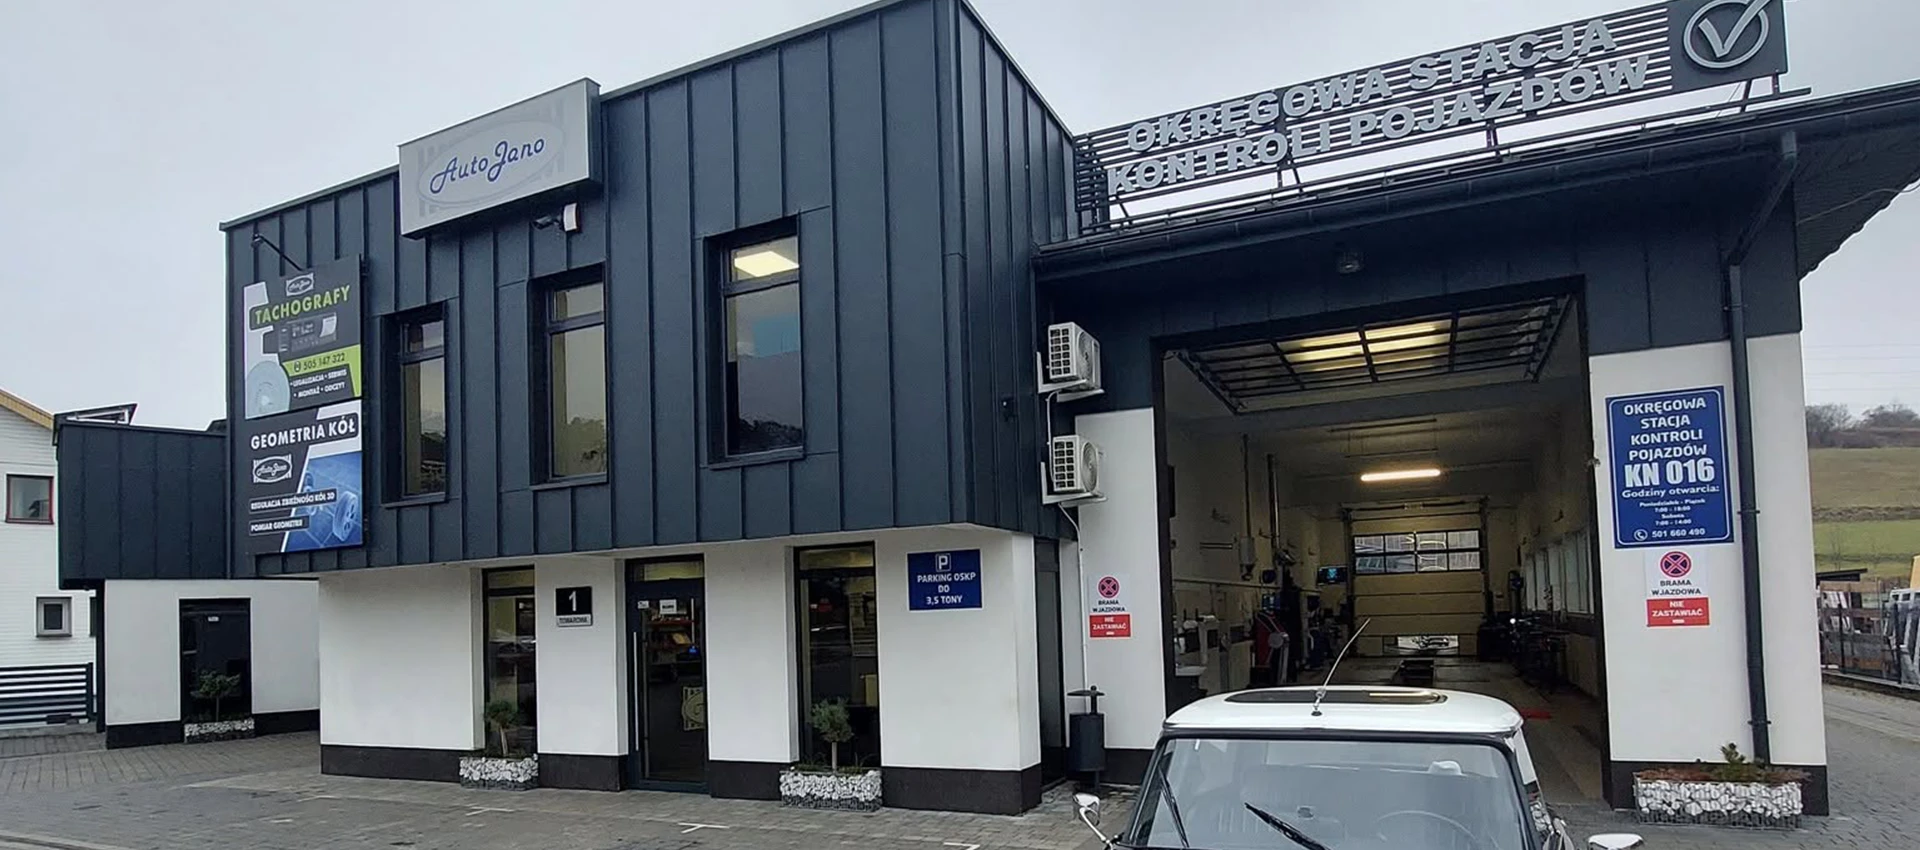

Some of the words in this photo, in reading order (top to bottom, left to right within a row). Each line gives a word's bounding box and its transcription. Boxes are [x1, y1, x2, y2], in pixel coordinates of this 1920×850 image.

[1127, 68, 1393, 152] OKRĘGOWA
[1409, 20, 1617, 90] STACJA
[1107, 121, 1331, 195] KONTROLI
[1350, 55, 1649, 147] POJAZDÓW
[255, 285, 350, 324] TACHOGRAFY
[303, 359, 317, 371] 505
[331, 352, 345, 364] 322
[324, 381, 345, 392] ODCZYT
[1623, 397, 1707, 416] OKRĘGOWA
[1640, 415, 1691, 429] STACJA
[251, 424, 325, 450] GEOMETRIA
[328, 416, 356, 437] KÓŁ
[1630, 429, 1703, 445] KONTROLI
[1629, 443, 1708, 461] POJAZDÓW
[1624, 462, 1660, 488] KN
[1666, 457, 1715, 485] 016
[1622, 488, 1666, 498] Godziny
[1669, 484, 1720, 496] otwarcia:
[1652, 530, 1668, 538] 501
[1670, 529, 1687, 537] 660
[1688, 528, 1706, 536] 490
[938, 555, 949, 570] P
[917, 573, 952, 583] PARKING
[953, 571, 976, 581] OSKP
[937, 584, 950, 593] DO
[1651, 588, 1702, 596] WJAZDOWA
[568, 590, 577, 612] 1
[926, 596, 939, 605] 3,5
[940, 594, 963, 604] TONY
[1669, 600, 1685, 608] NIE
[1652, 608, 1704, 617] ZASTAWIAĆ
